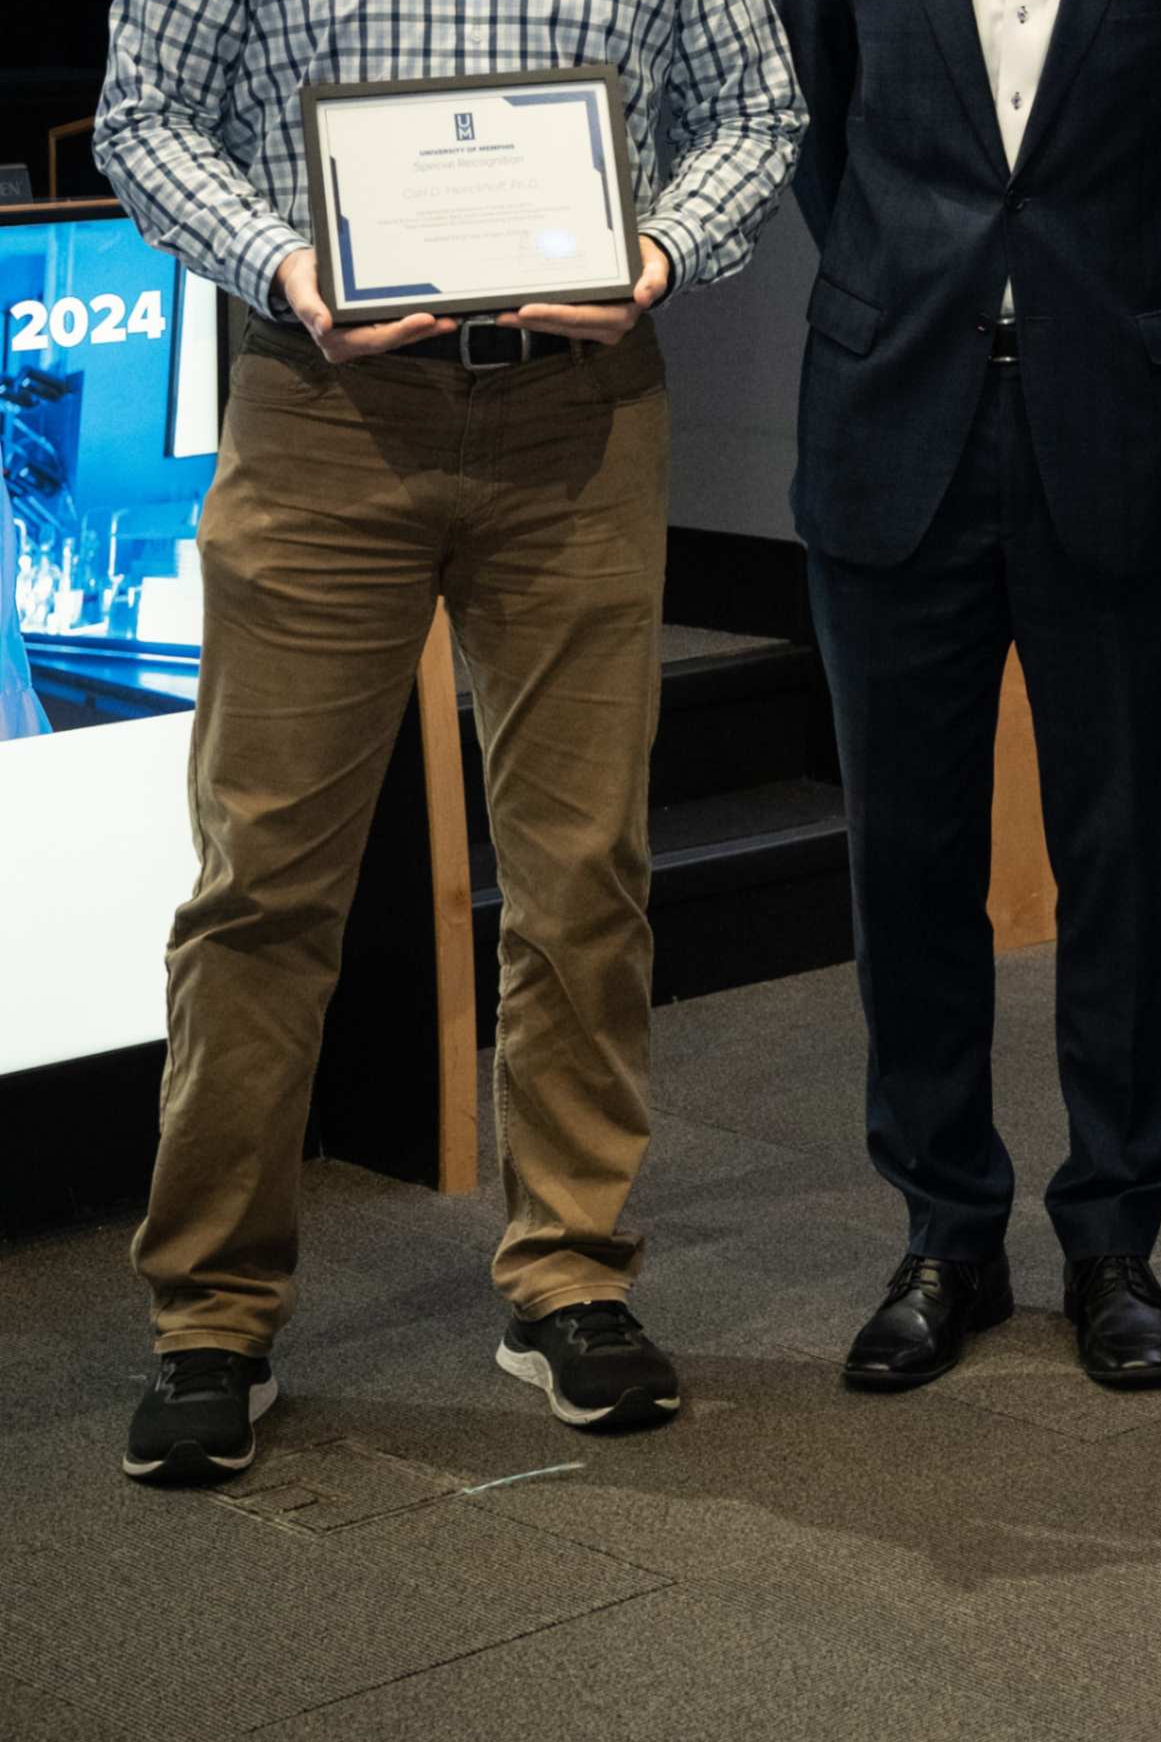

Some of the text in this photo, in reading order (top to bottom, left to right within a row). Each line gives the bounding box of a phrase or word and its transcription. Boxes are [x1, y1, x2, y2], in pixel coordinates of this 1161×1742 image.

[419, 147, 465, 156] UNIVERSITY
[479, 143, 515, 152] MEMPHIS
[10, 290, 166, 352] 2024
